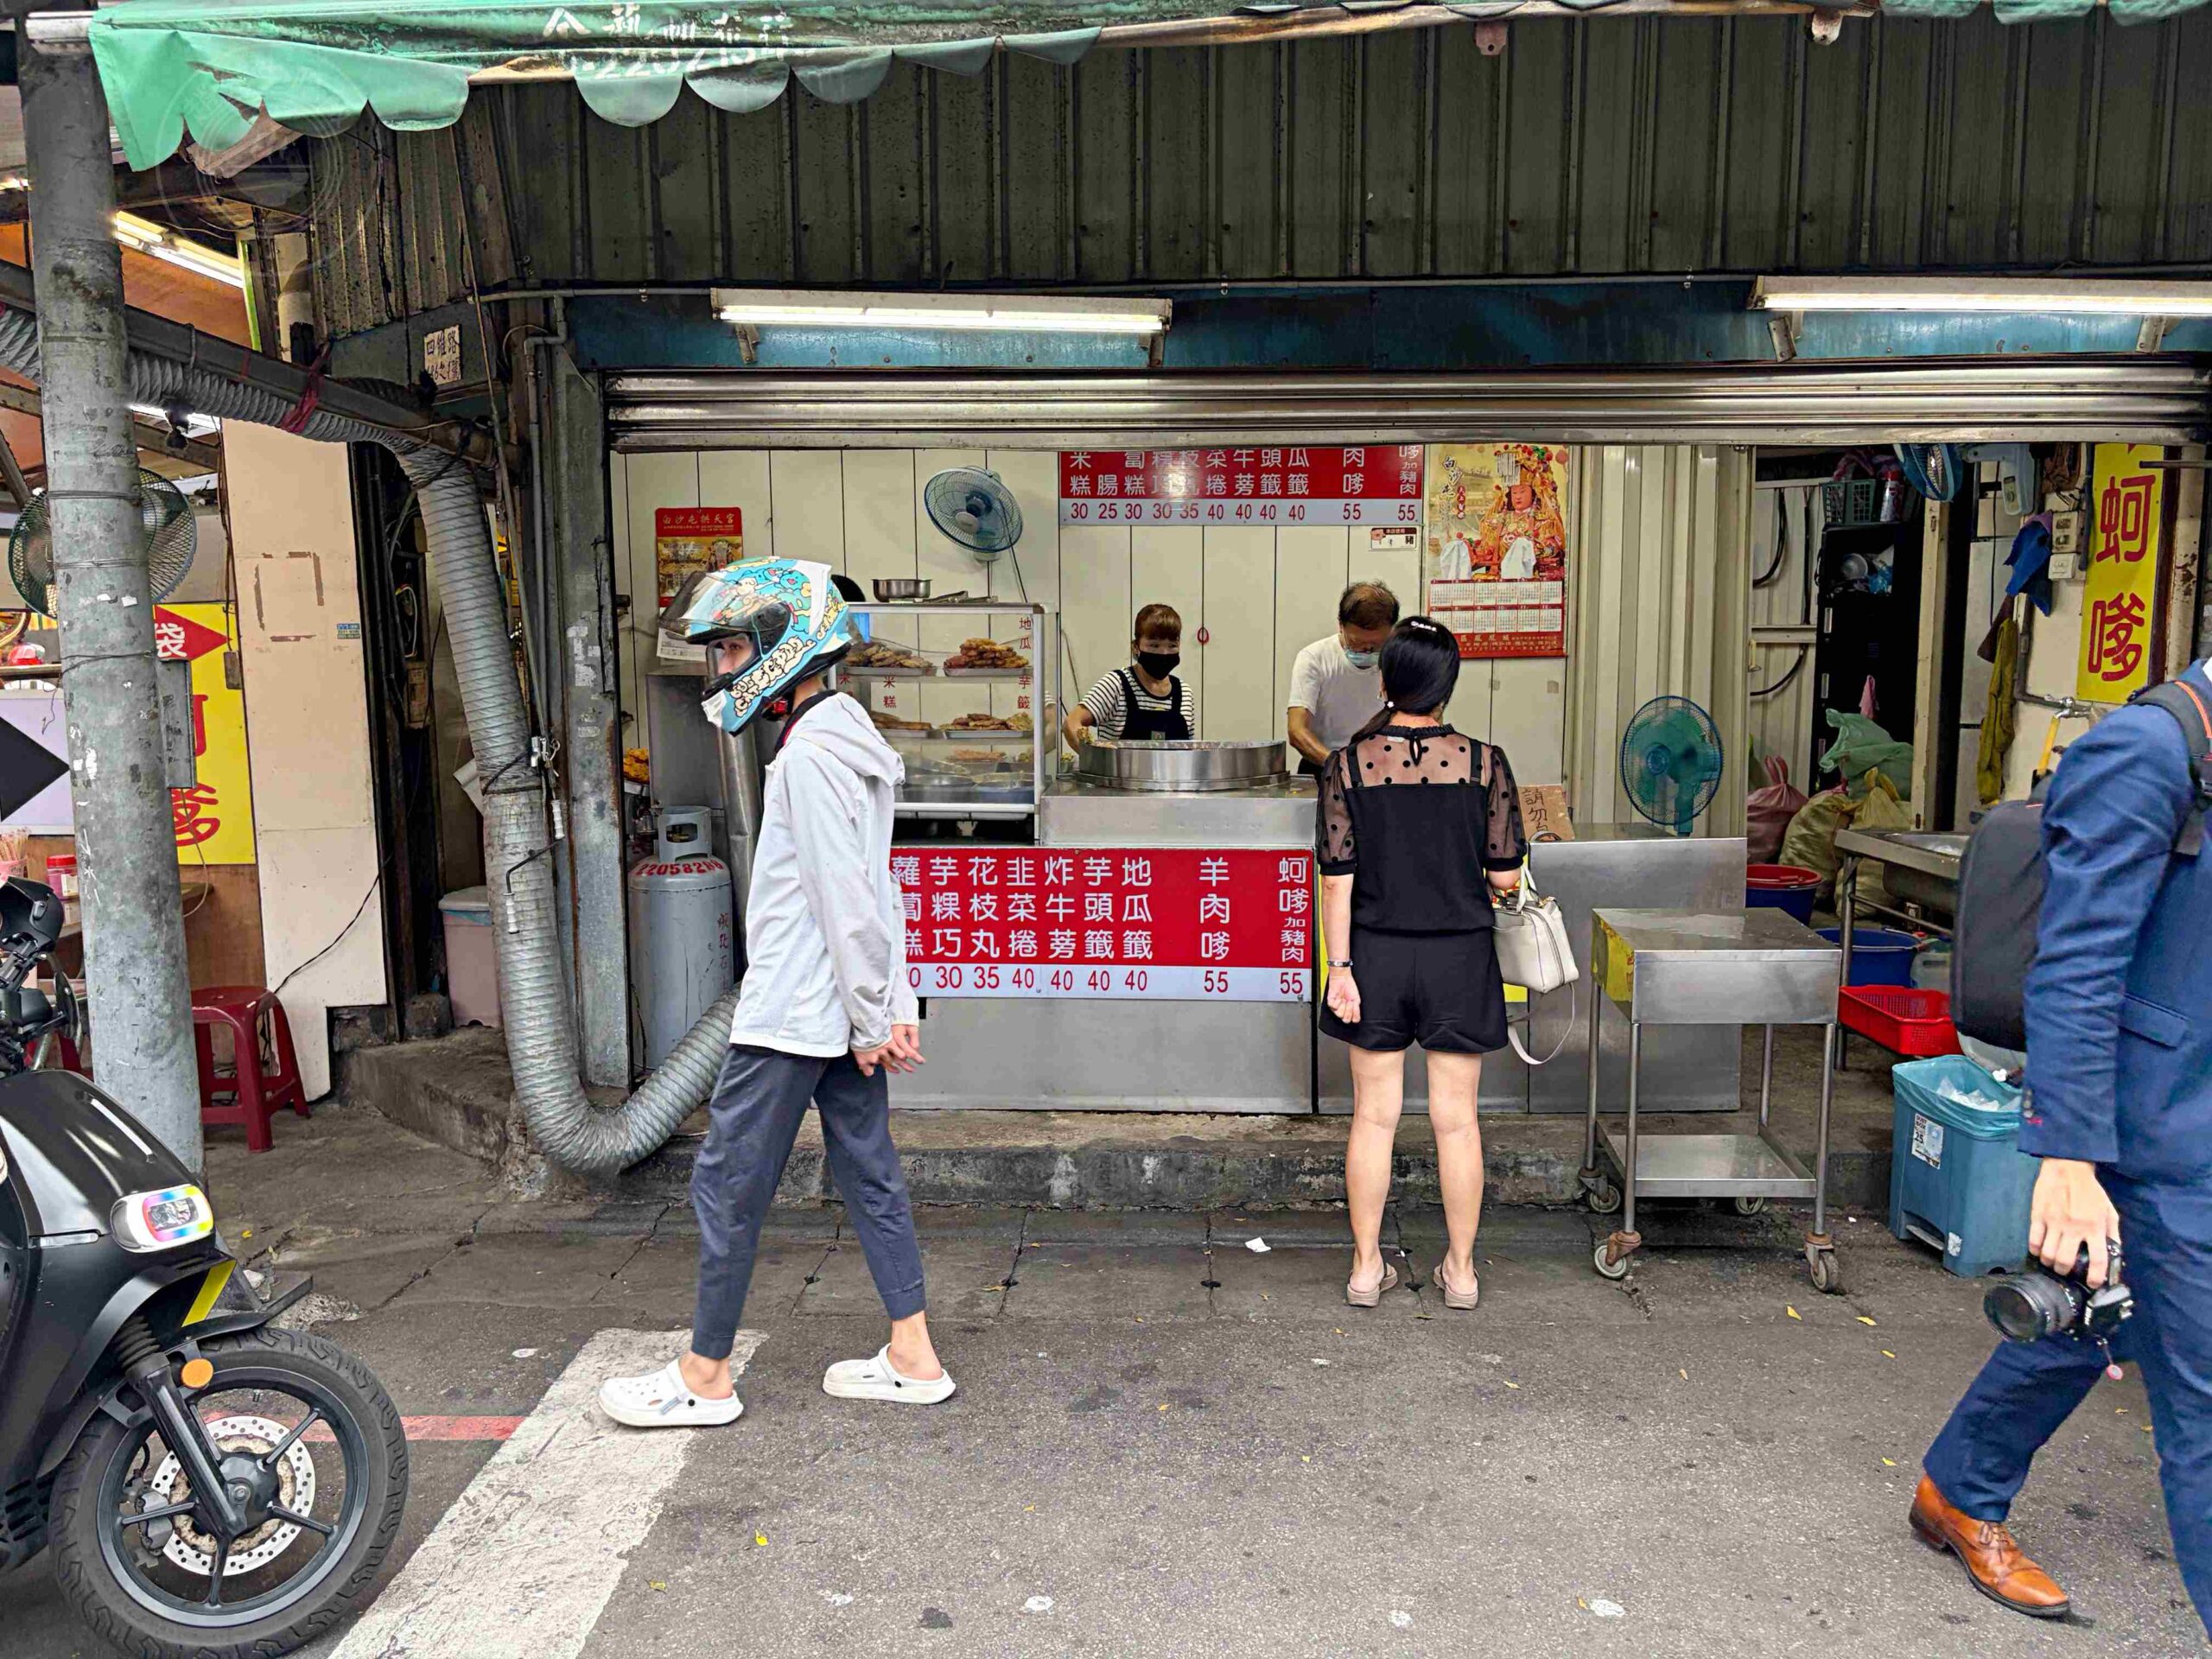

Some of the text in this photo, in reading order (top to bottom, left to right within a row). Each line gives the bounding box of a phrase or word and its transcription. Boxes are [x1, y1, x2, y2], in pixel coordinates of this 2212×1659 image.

[1071, 503, 1415, 520] 30 25 30 30 35 40 40 40 40 55 55
[1097, 474, 1118, 496] 腸
[2088, 474, 2156, 682] 蚵嗲
[1019, 616, 1033, 650] 地瓜
[882, 676, 897, 709] 米糕
[929, 856, 962, 958] 芋粿巧
[968, 856, 1001, 958] 花枝丸
[1006, 856, 1038, 958] 韭菜捲
[1045, 856, 1077, 959] 炸牛蒡
[1083, 856, 1114, 960] 芋頭籤
[1122, 856, 1153, 960] 地瓜籤
[1199, 856, 1230, 960] 羊肉嗲
[906, 966, 1303, 995] 0 30 35 40 40 40 40 55 55
[1914, 1131, 1924, 1144] 25
